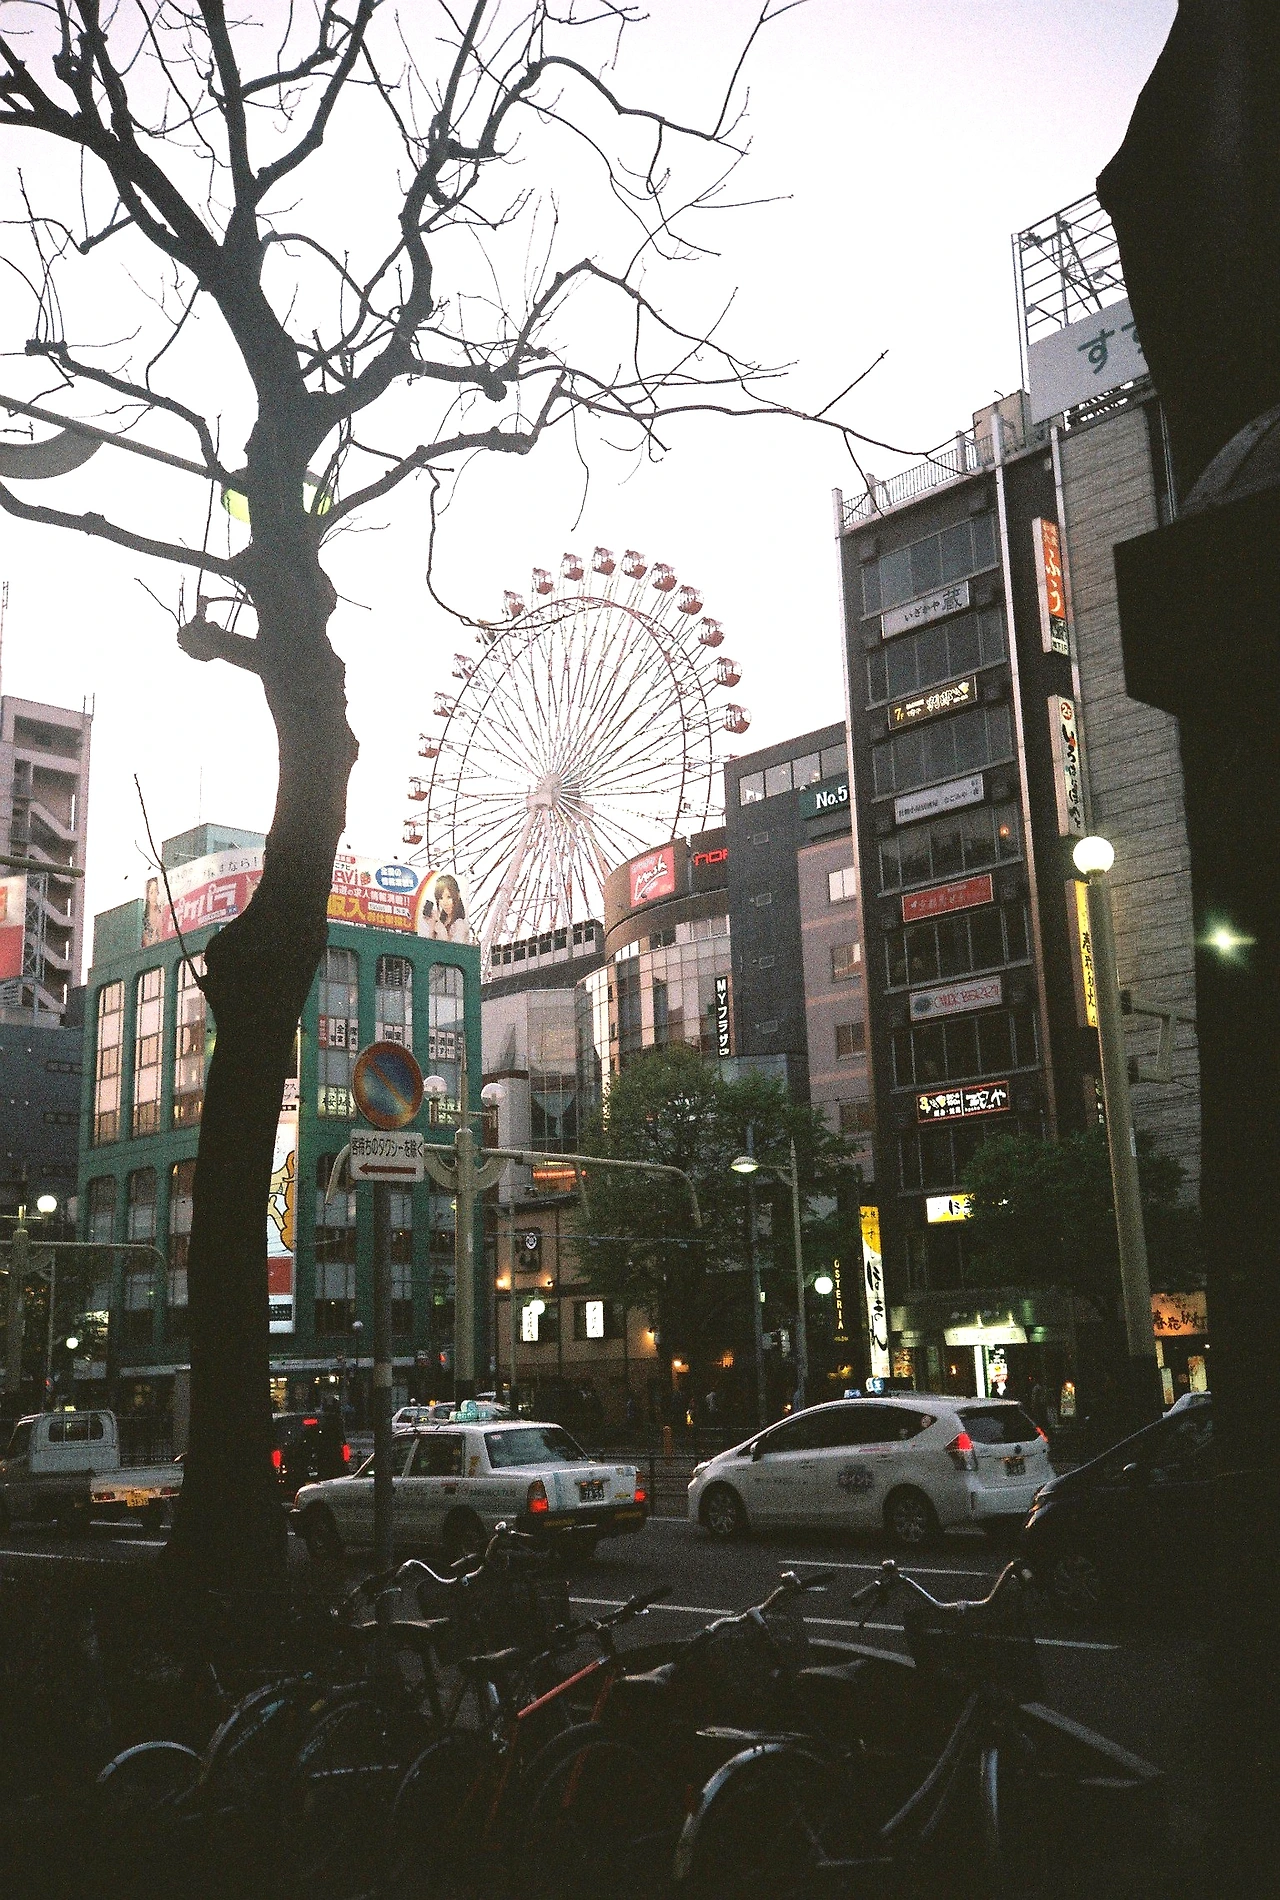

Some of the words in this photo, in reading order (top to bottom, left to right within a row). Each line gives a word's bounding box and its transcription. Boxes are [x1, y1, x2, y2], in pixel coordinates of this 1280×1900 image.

[816, 785, 848, 809] No.5
[352, 1137, 423, 1158] 客待ちのタクシーを除く
